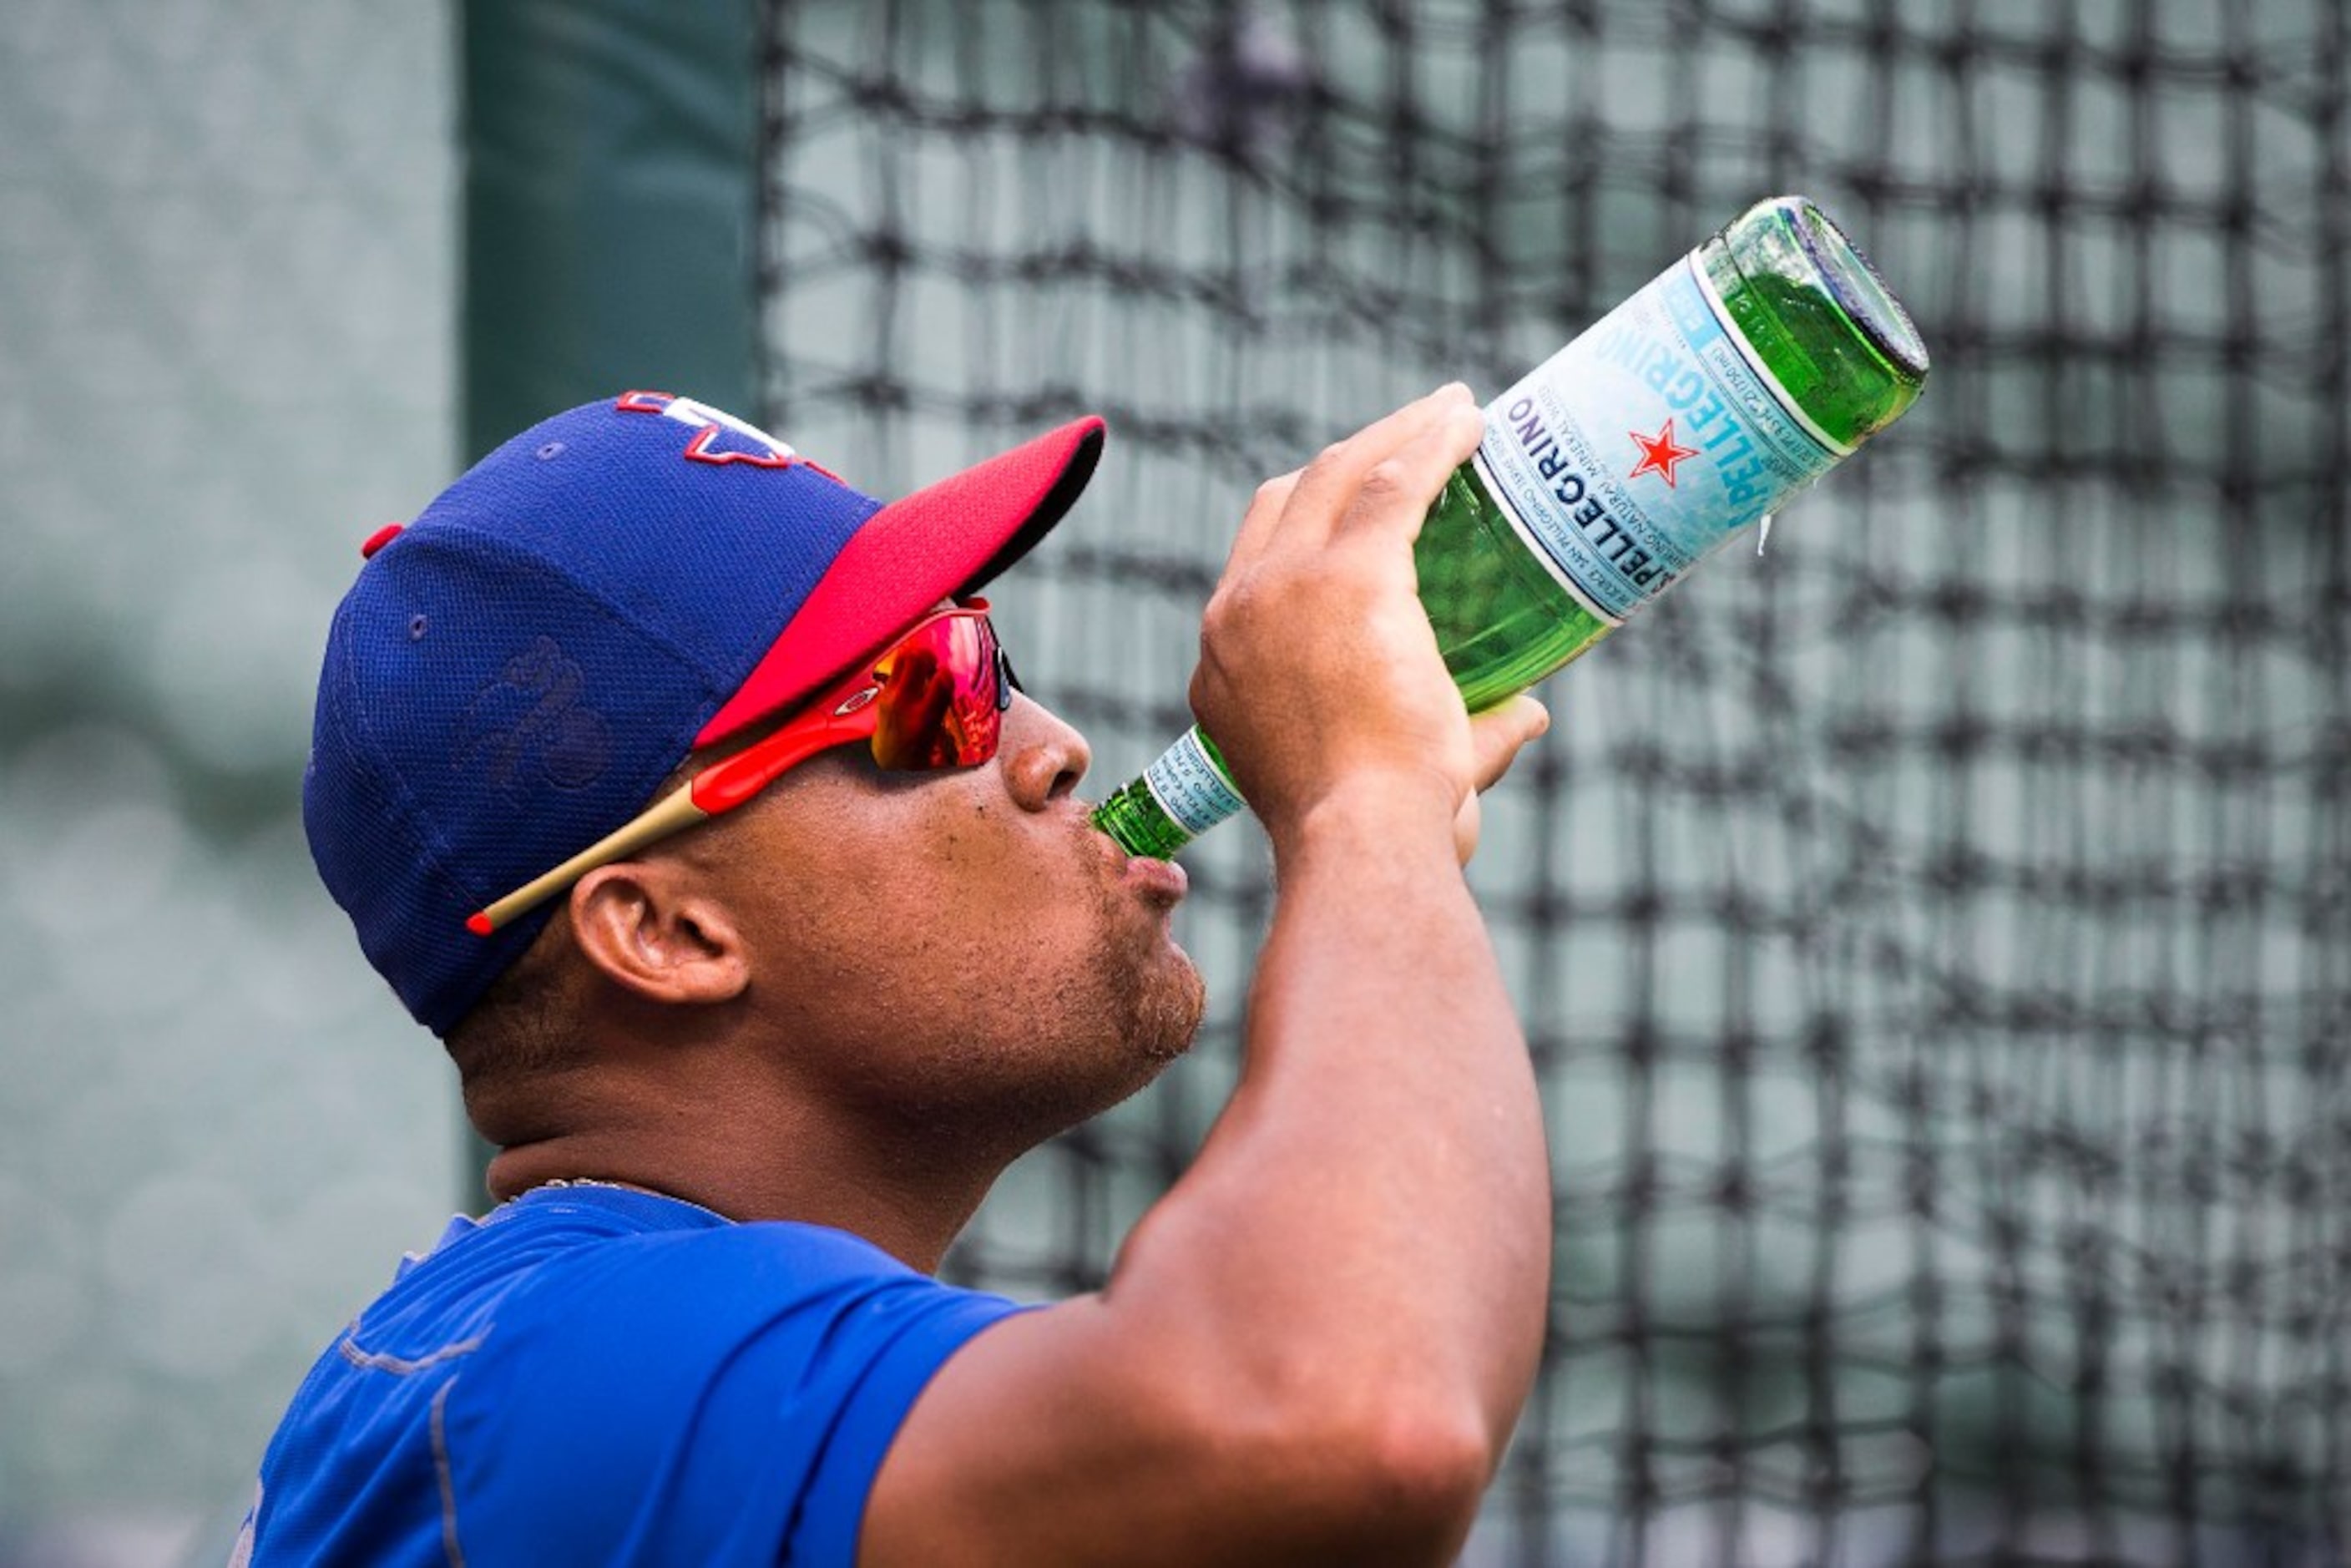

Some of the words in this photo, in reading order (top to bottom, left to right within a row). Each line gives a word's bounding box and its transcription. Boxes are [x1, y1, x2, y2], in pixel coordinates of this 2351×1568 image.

[1724, 366, 1749, 393] (750
[1555, 418, 1600, 478] MINERAL
[1508, 398, 1675, 595] S.PELLEGRINO
[1521, 487, 1570, 549] PELLEGRINO
[1566, 546, 1589, 569] SAN
